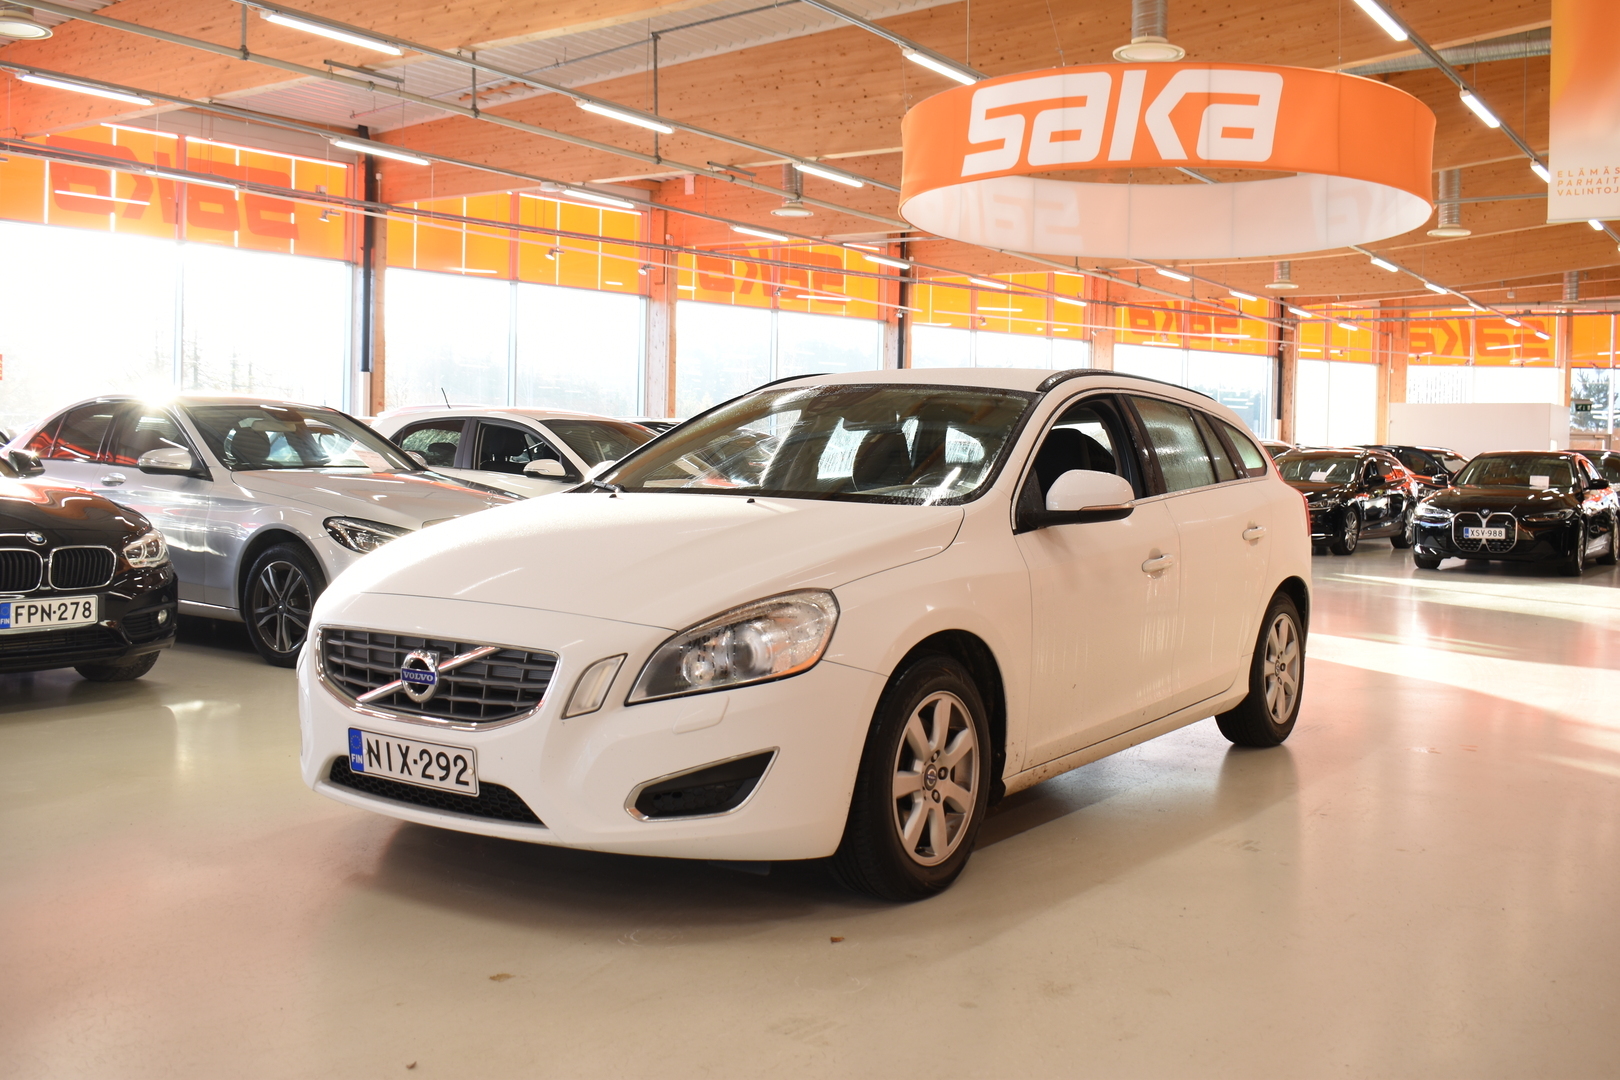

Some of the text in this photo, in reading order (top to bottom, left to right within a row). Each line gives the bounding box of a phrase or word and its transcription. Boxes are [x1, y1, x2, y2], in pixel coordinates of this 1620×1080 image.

[1557, 165, 1620, 178] ELÄMÄS
[1557, 176, 1619, 187] PARHAIT
[1557, 186, 1619, 197] VALINTOJ
[15, 601, 92, 624] FPN-278
[402, 670, 434, 682] VOLVO
[351, 738, 470, 787] FIN NIX-292
